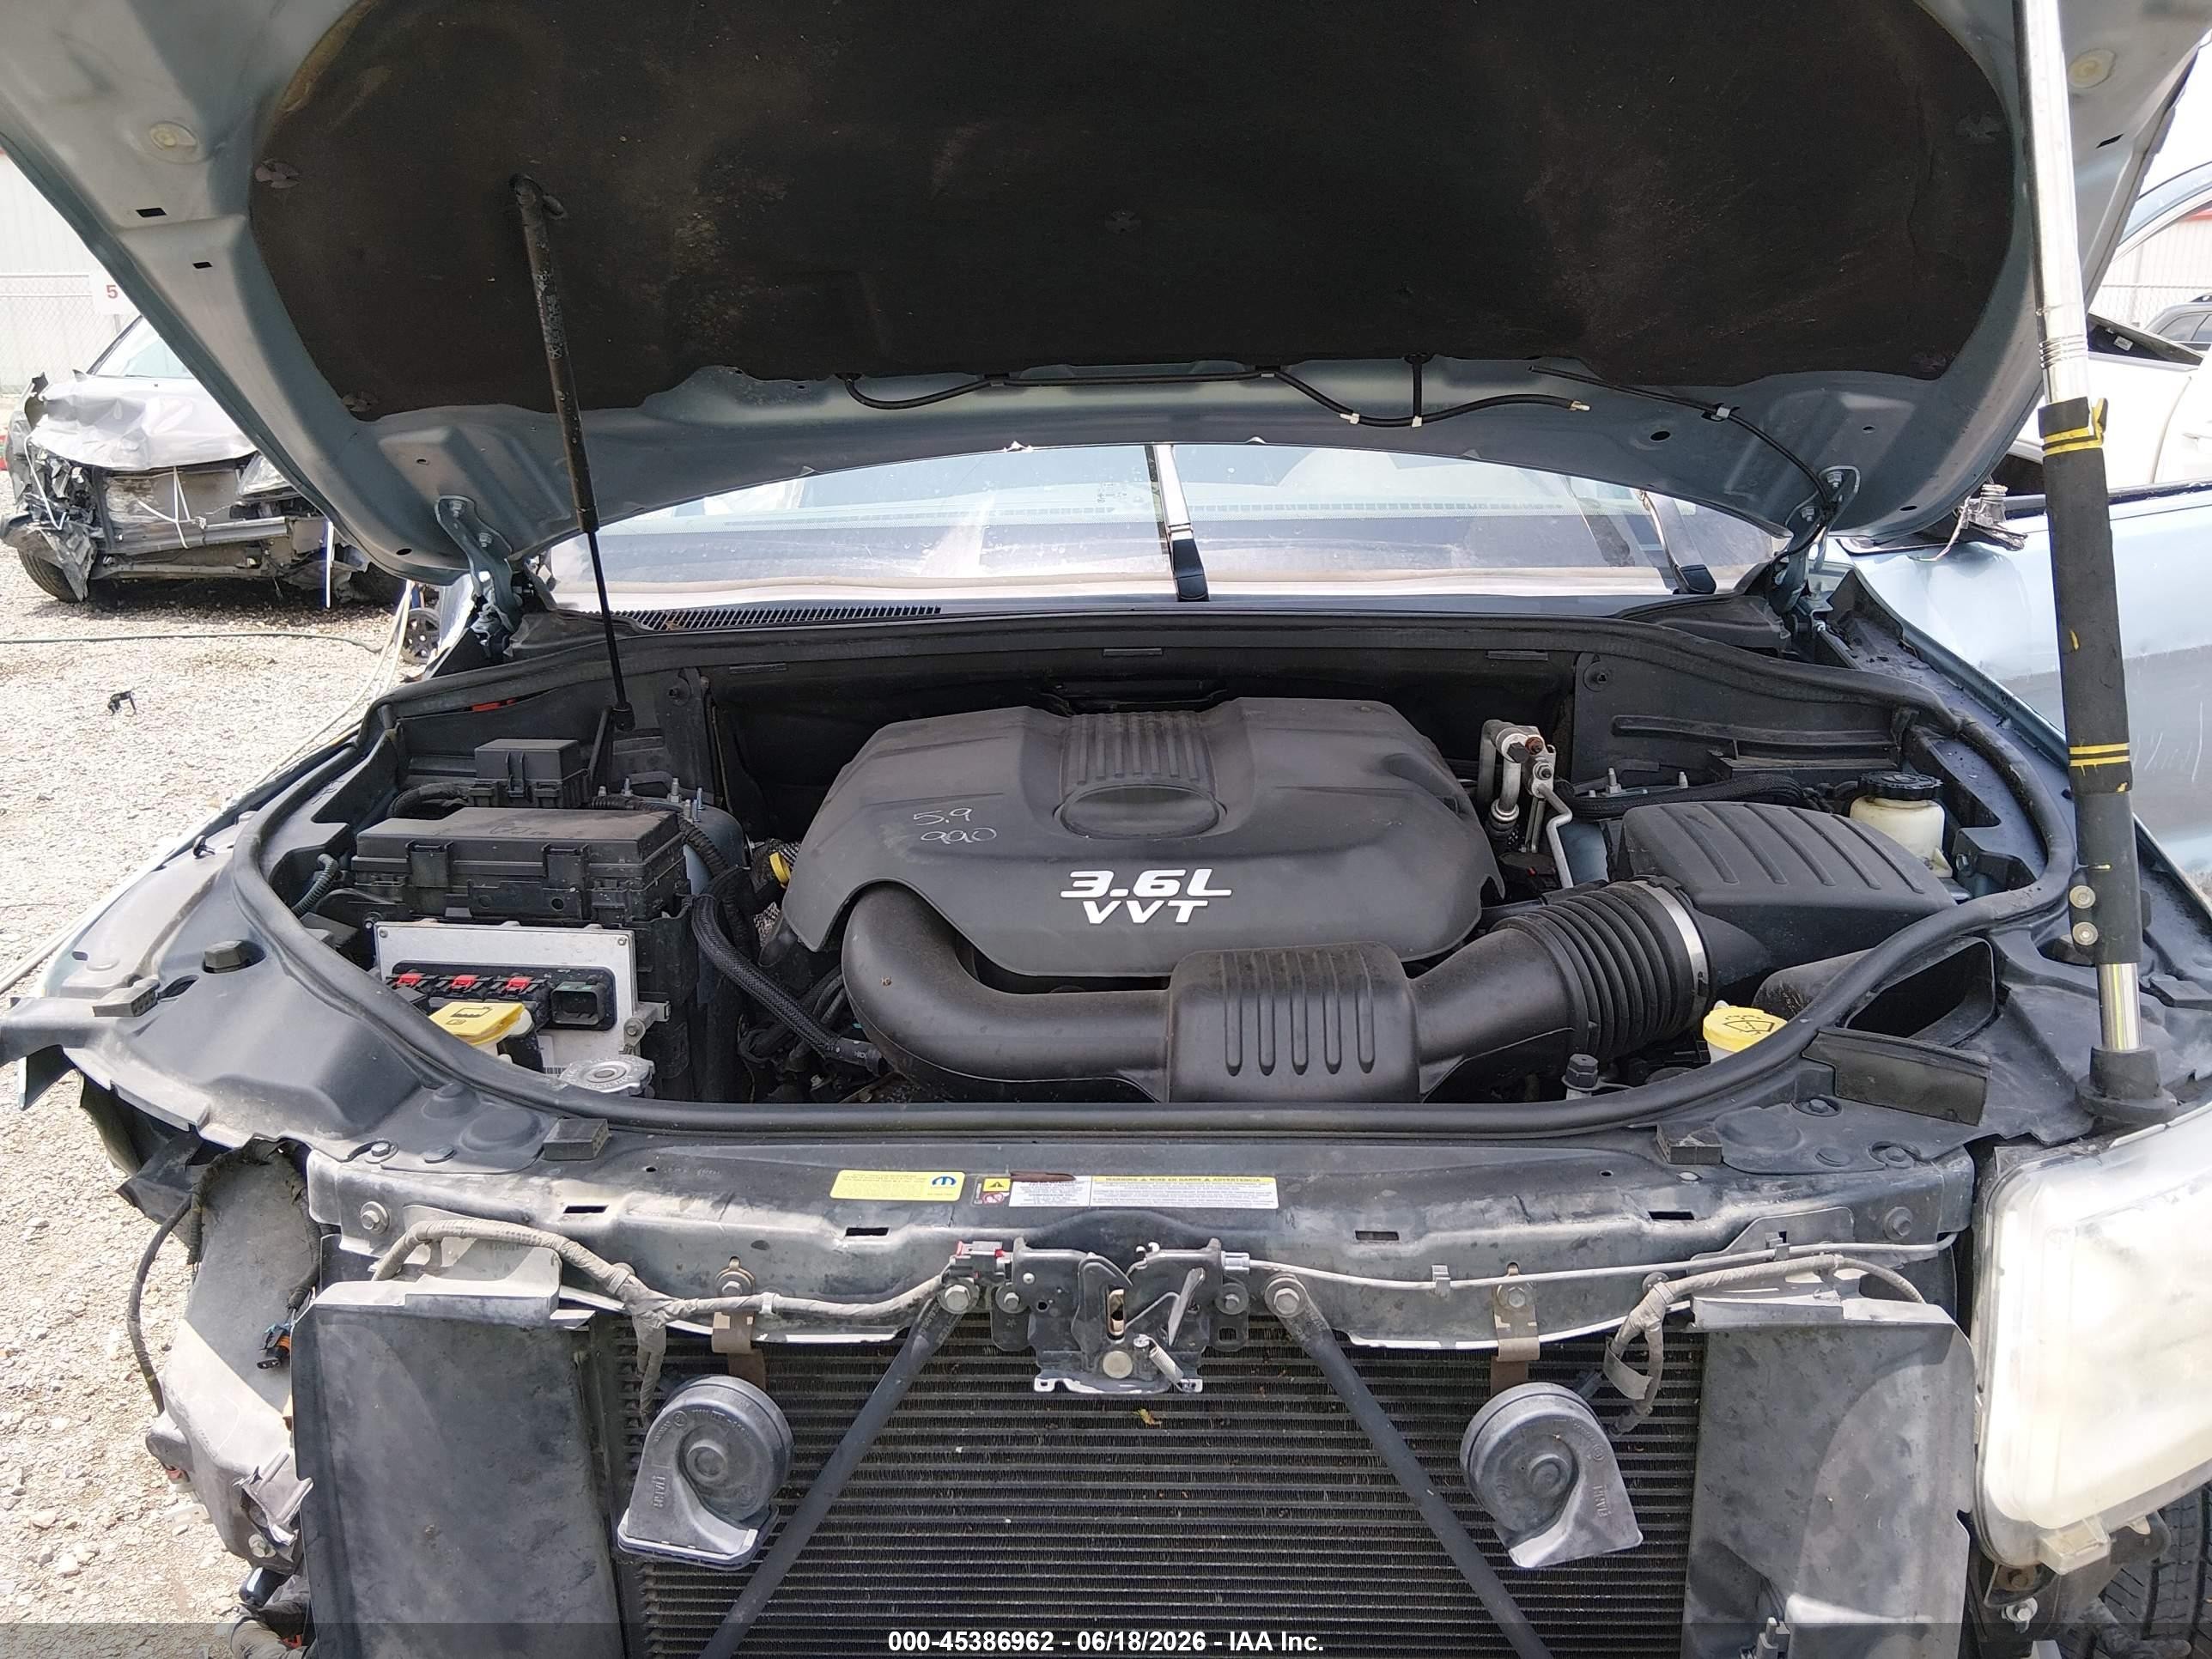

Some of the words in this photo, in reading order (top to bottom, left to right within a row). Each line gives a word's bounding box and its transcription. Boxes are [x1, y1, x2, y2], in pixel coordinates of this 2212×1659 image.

[106, 285, 118, 299] 5
[913, 807, 974, 826] 5.9
[1060, 869, 1232, 897] 3.6L
[1083, 900, 1208, 924] VVT
